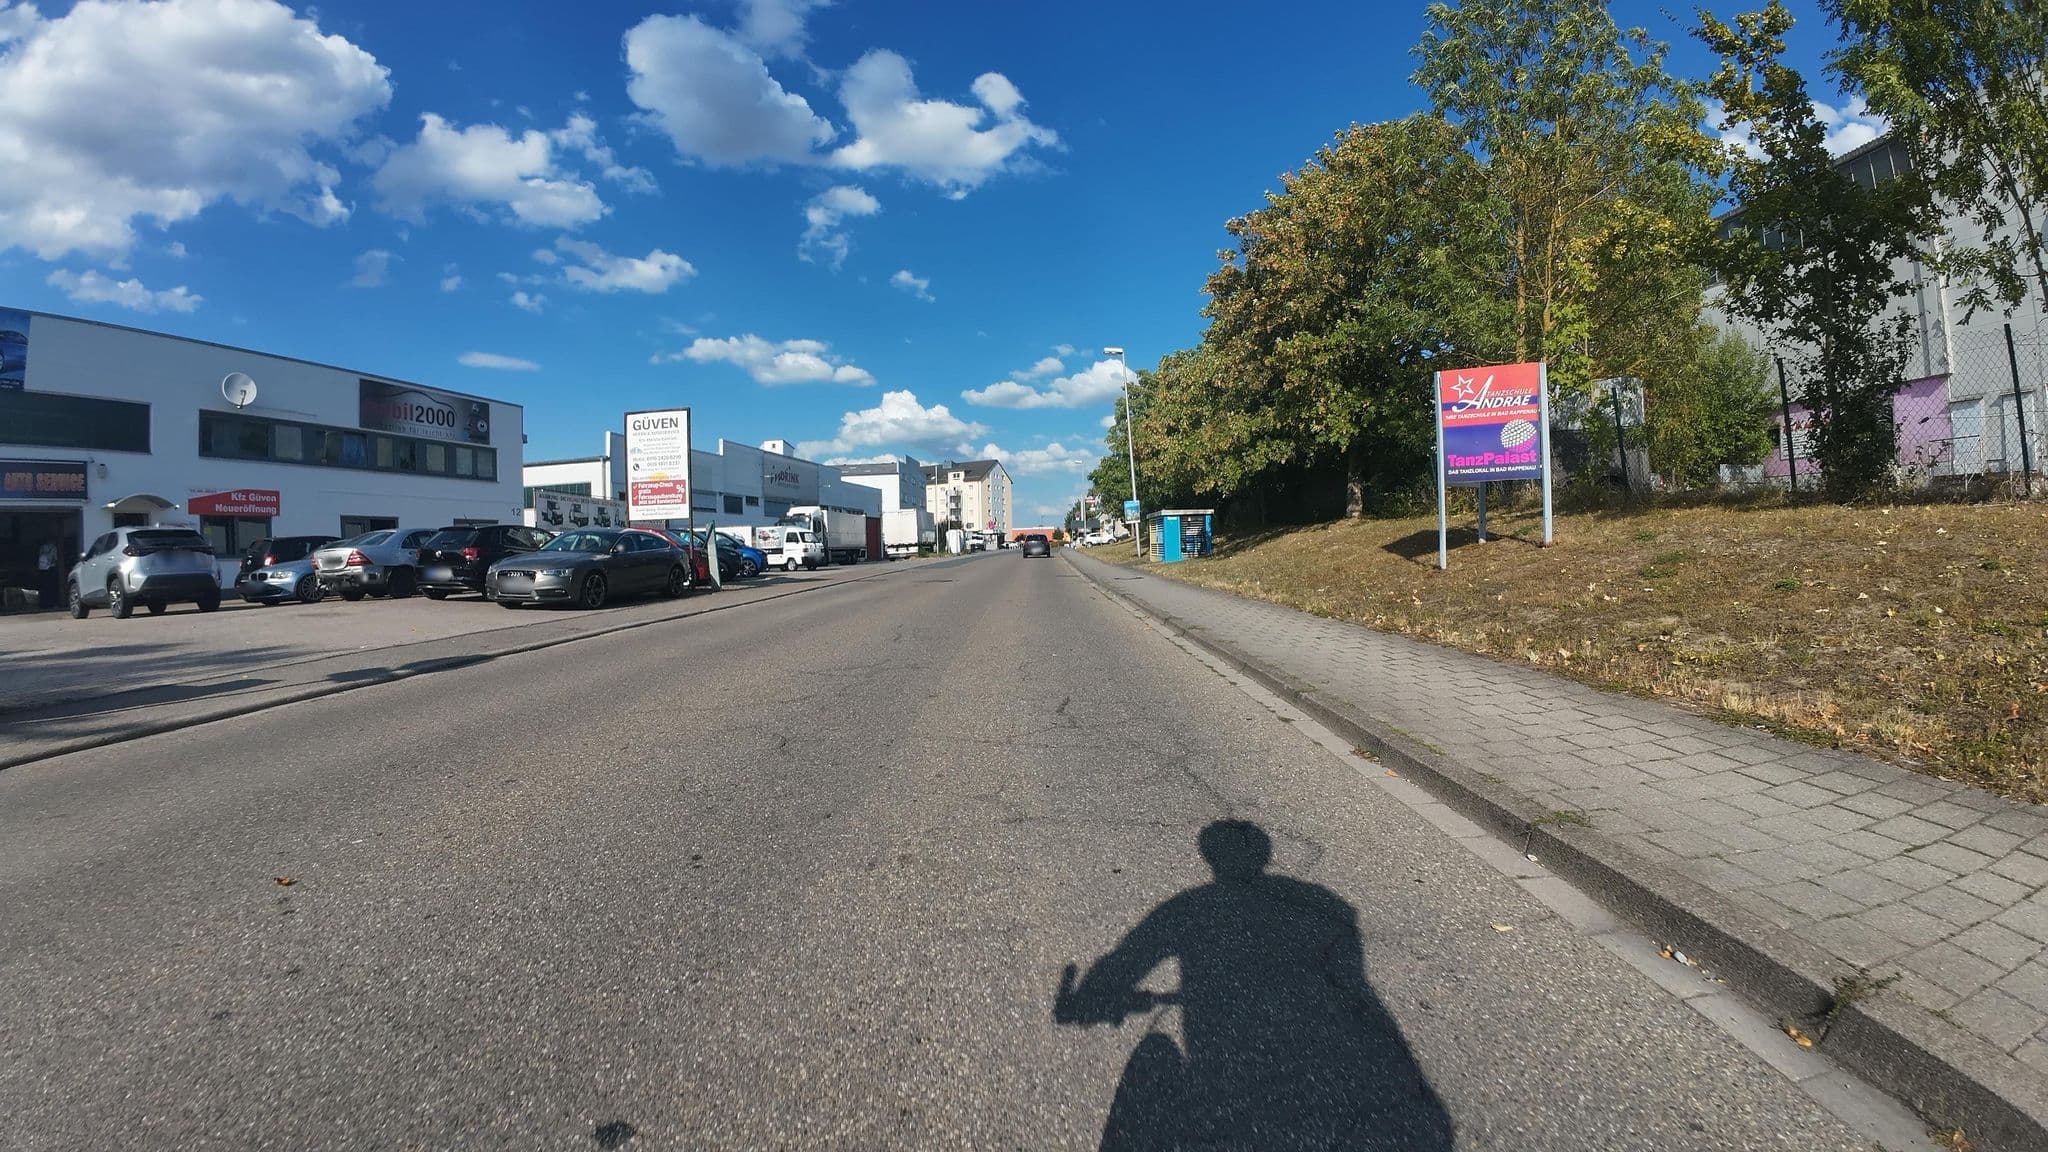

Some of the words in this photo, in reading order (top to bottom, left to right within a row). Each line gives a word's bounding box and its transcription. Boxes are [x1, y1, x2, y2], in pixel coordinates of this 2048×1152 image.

[1452, 375, 1532, 413] ANDRAE
[1486, 387, 1532, 398] TANZSCHULE
[632, 416, 679, 431] GÜVEN
[1447, 450, 1537, 467] TanzPalast
[4, 472, 33, 491] AUTO
[36, 472, 85, 492] SERVICE
[231, 492, 247, 502] Kfz
[248, 493, 277, 503] Güven
[215, 503, 277, 515] Neueröffnung
[511, 507, 521, 516] 12
